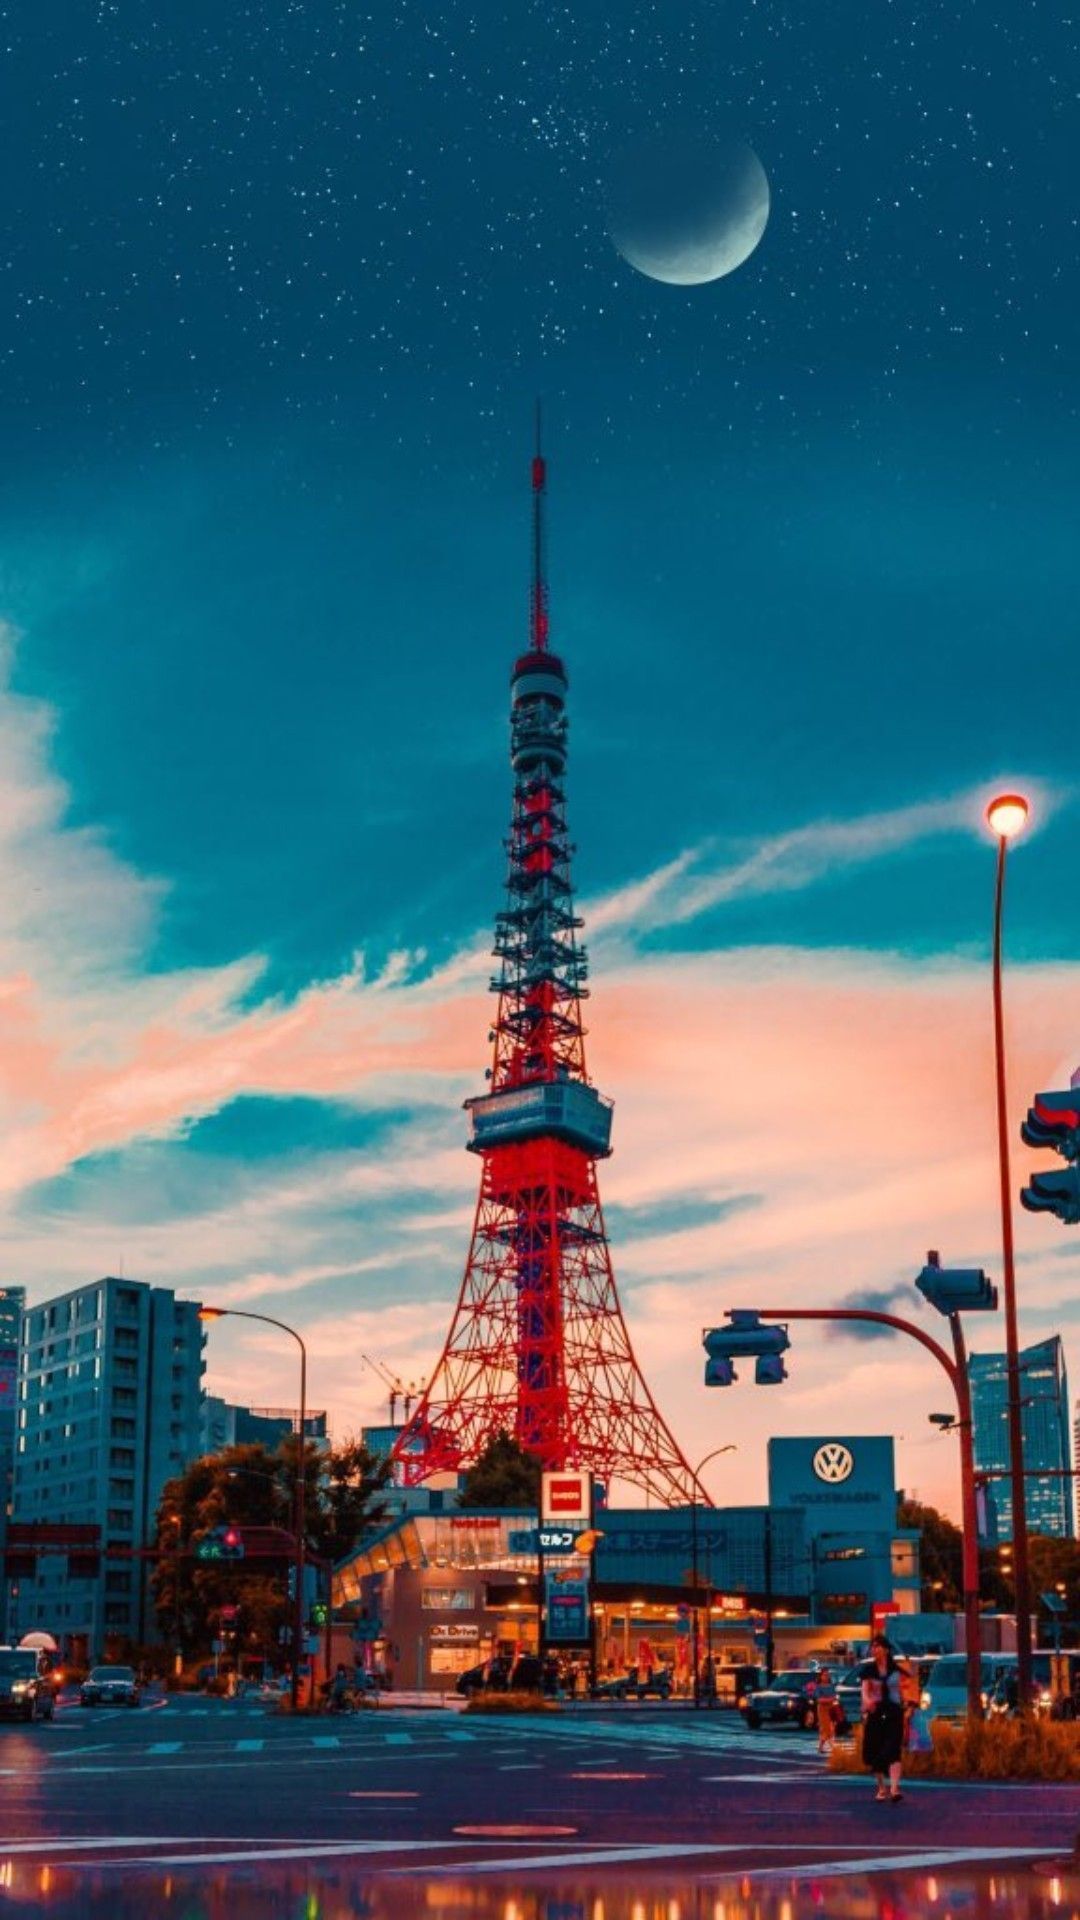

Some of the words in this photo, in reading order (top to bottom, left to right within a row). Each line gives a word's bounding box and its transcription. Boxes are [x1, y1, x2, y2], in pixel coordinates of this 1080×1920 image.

[813, 1443, 853, 1482] VW
[540, 1533, 573, 1546] セルフ
